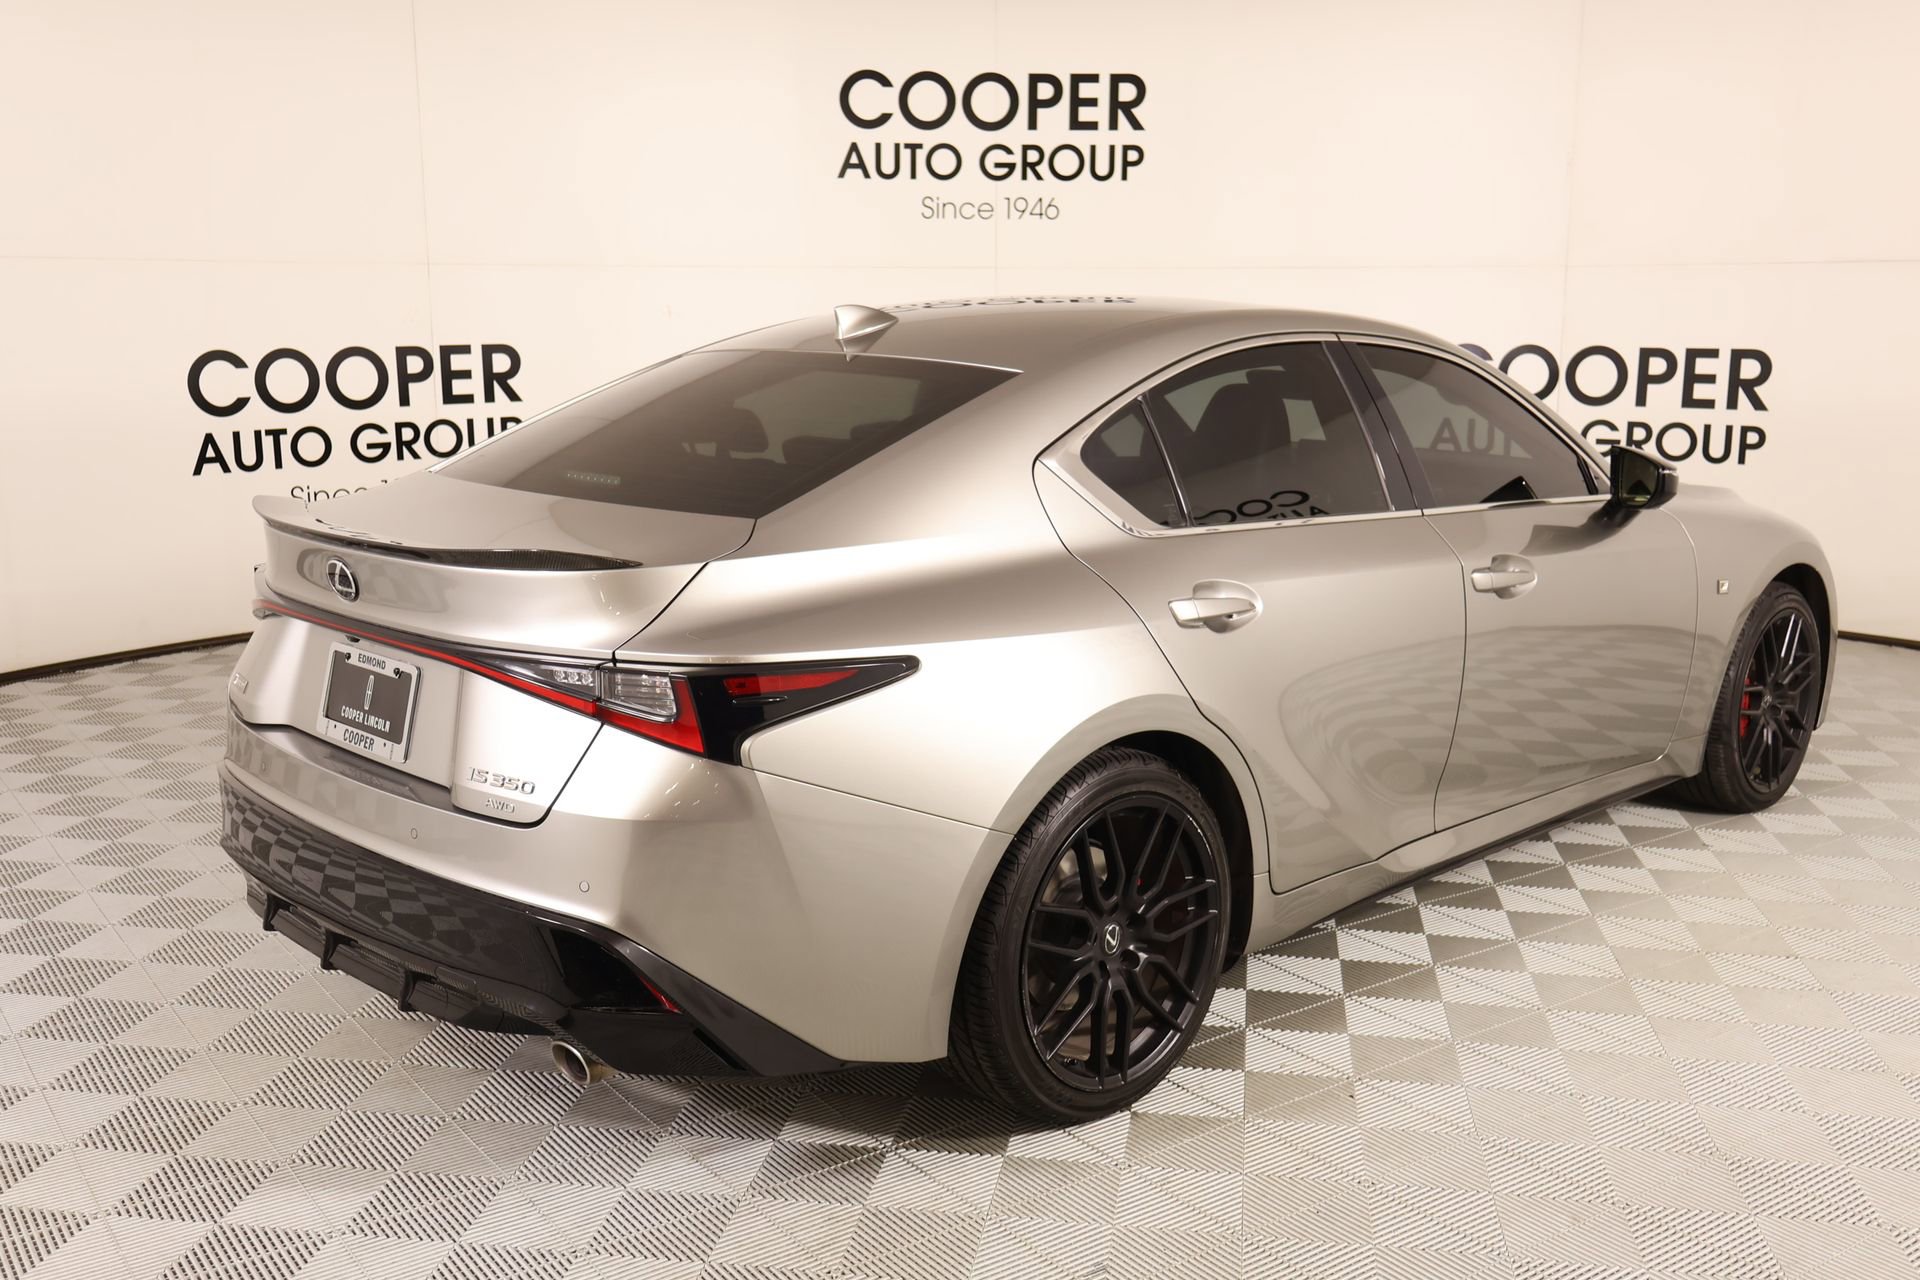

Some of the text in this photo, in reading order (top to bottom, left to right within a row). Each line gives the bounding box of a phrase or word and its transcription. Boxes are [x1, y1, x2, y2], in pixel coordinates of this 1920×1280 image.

[839, 69, 1147, 131] COOPER
[838, 142, 1145, 181] AUTO GROUP
[921, 196, 1060, 220] Since 1946
[187, 344, 523, 417] COOPER
[192, 427, 333, 476] AUTO
[1580, 419, 1768, 465] GROUP
[357, 653, 387, 670] EDMOND
[341, 705, 391, 733] COOPER LINCOLN
[343, 728, 375, 751] COOPER
[467, 766, 536, 795] IS 350
[485, 798, 516, 814] AWD
